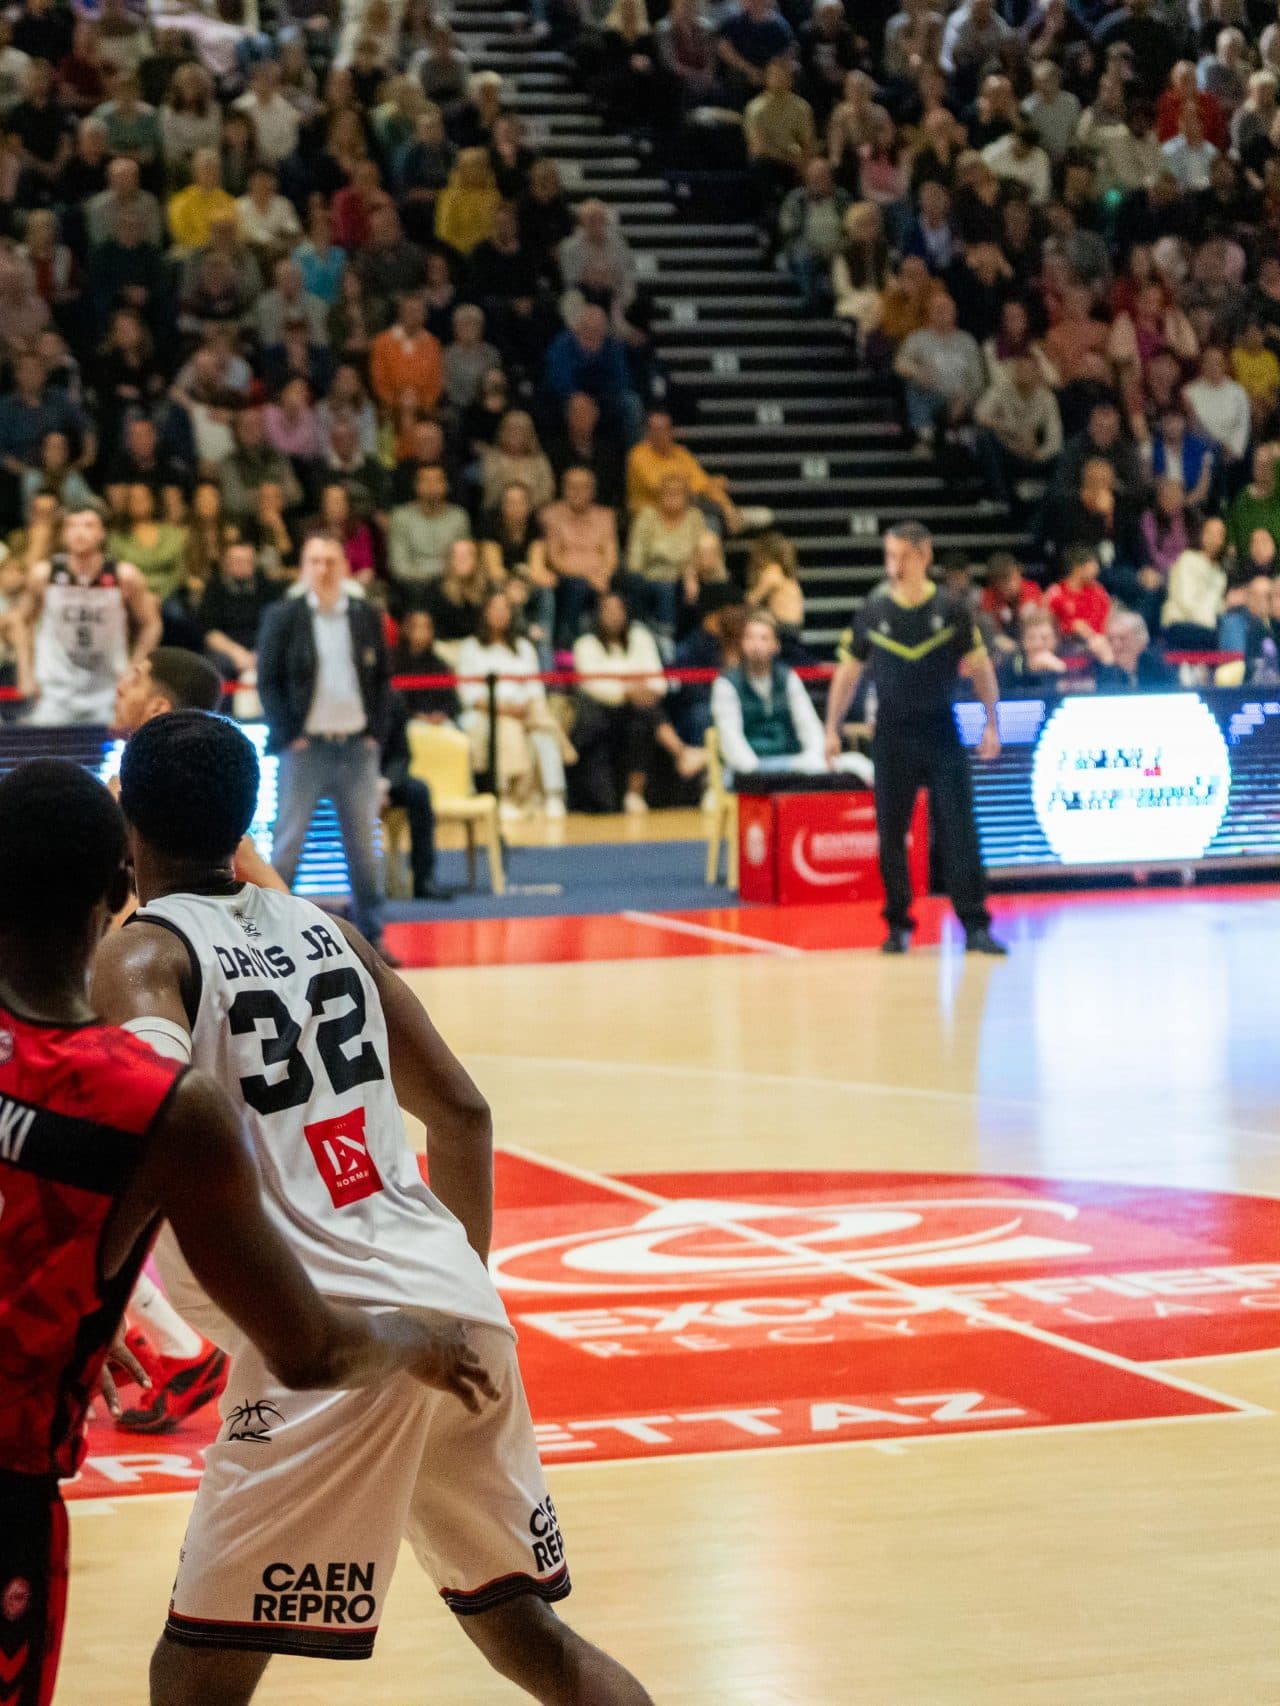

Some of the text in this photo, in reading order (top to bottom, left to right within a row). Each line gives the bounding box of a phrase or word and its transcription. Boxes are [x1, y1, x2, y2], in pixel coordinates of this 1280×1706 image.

[213, 925, 344, 980] DAVIS JR
[228, 966, 386, 1116] 32
[262, 1562, 376, 1592] CAEN
[253, 1594, 377, 1625] REPRO
